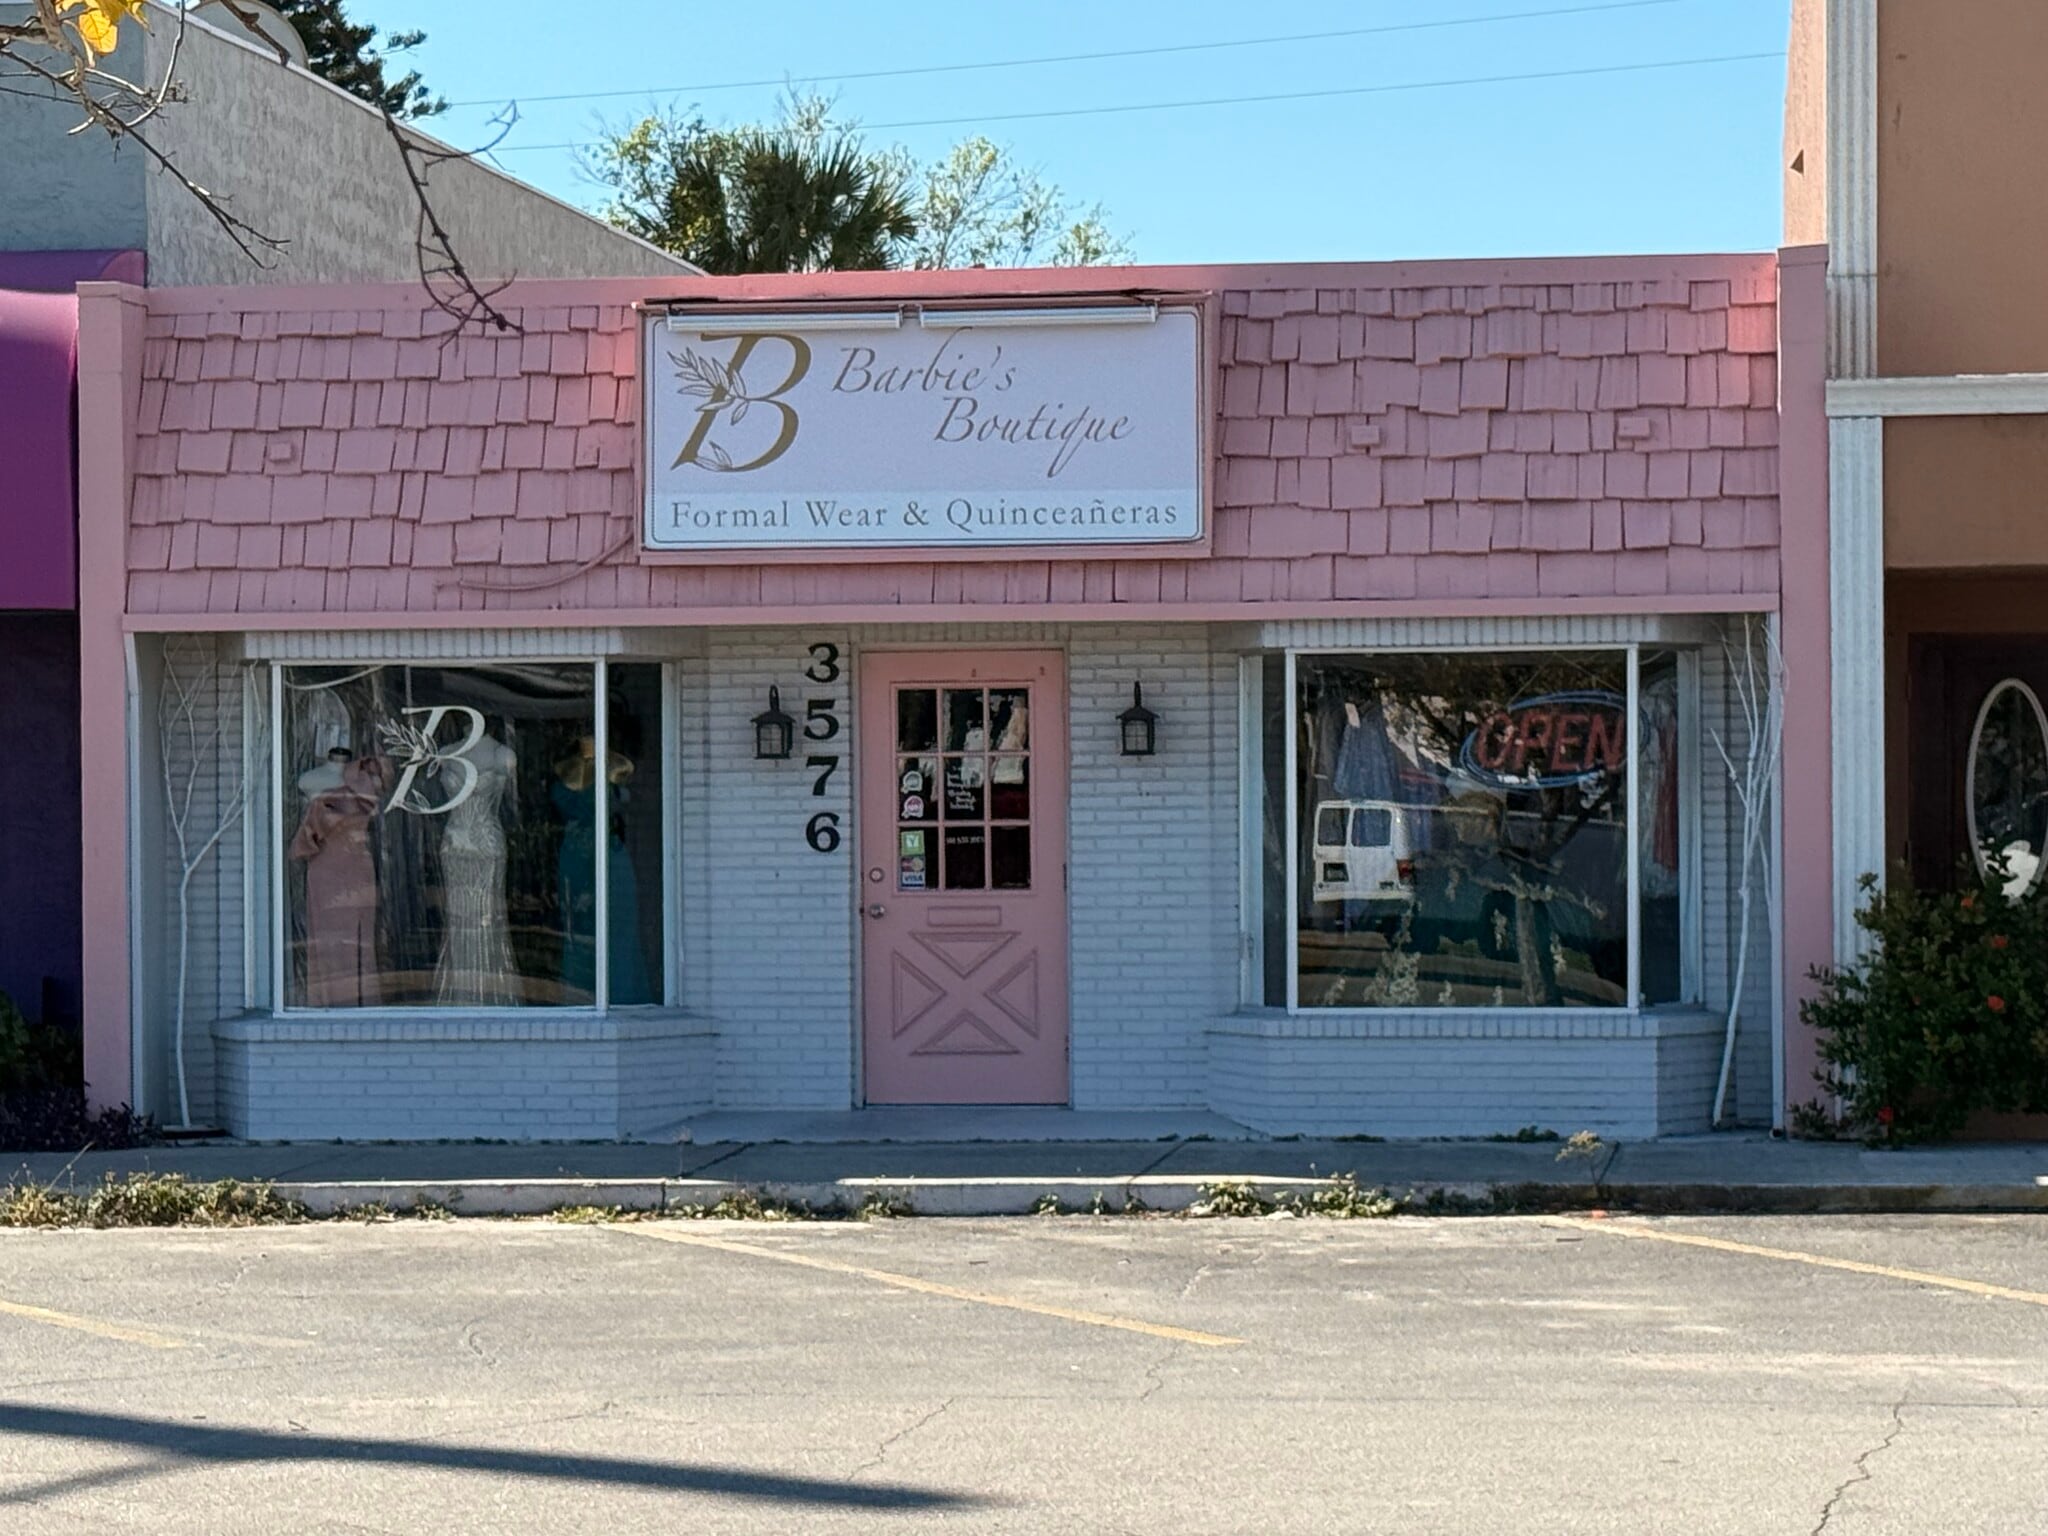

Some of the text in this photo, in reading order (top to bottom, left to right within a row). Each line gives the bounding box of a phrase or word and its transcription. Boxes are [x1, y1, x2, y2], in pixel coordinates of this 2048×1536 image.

[832, 326, 1017, 394] Barbie's
[934, 396, 1135, 478] Boutique
[671, 498, 1178, 534] Formal Wear & Quinceañeras
[804, 642, 841, 853] 3576
[1477, 709, 1626, 771] OPEN
